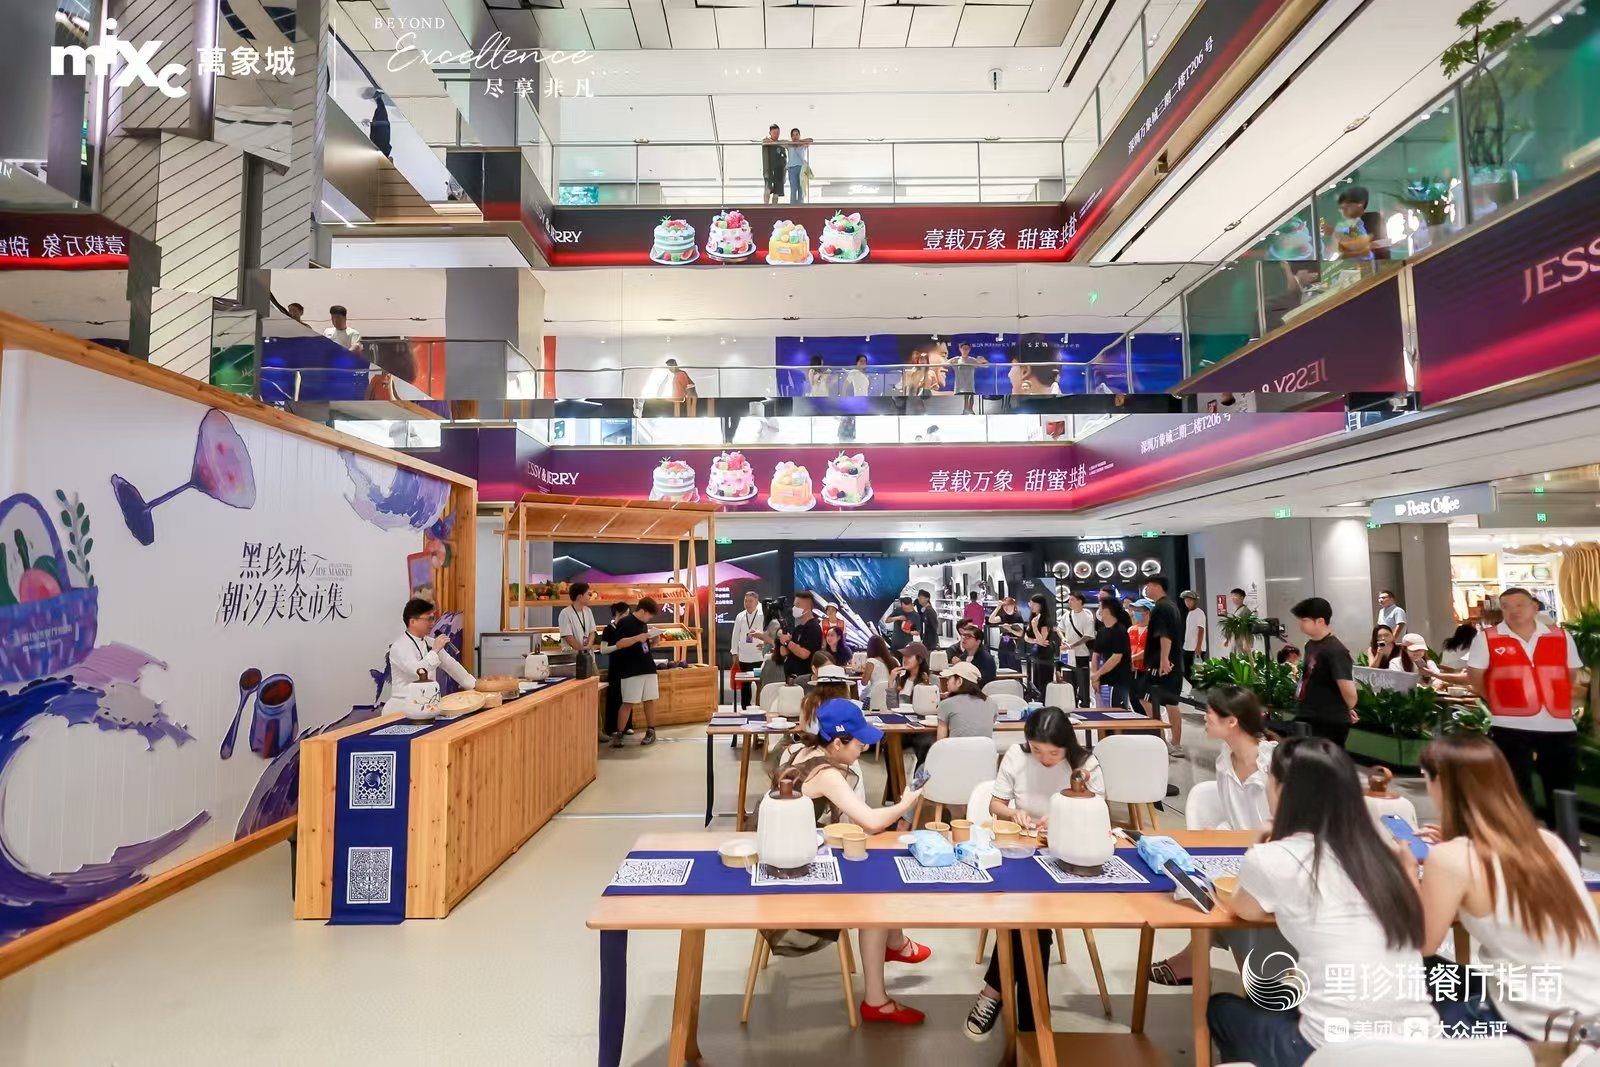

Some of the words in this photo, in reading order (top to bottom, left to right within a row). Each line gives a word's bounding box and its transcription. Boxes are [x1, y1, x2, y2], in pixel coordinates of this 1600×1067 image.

[923, 228, 1006, 250] 壹载万象
[928, 469, 1013, 492] 壹载万象
[1431, 496, 1460, 514] Coffee
[240, 541, 307, 583] 黑珍珠
